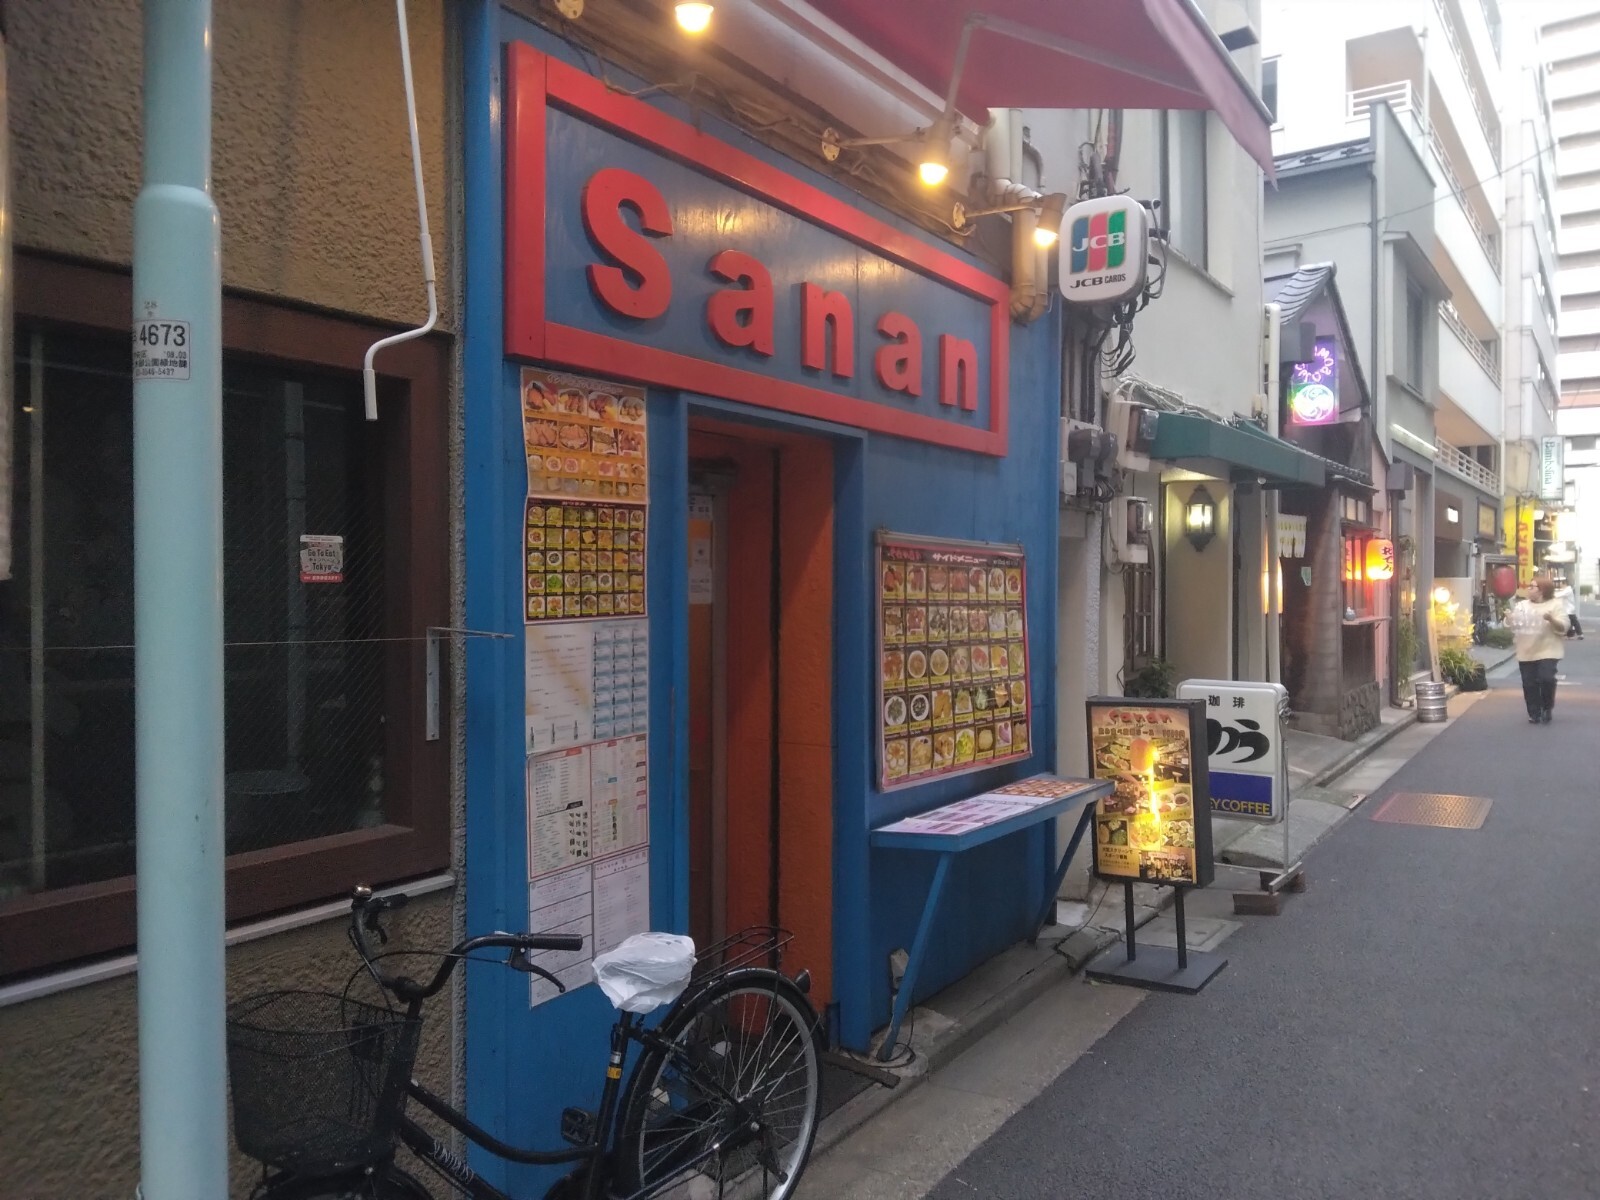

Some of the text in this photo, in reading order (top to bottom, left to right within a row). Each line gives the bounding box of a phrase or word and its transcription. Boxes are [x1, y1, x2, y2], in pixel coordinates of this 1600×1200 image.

[1072, 232, 1125, 252] JCB
[581, 167, 978, 411] Sanan
[1070, 273, 1126, 288] JCB CARDS
[140, 324, 186, 347] 4673
[932, 552, 988, 565] サイドメニュー
[1222, 800, 1271, 815] COFFEE
